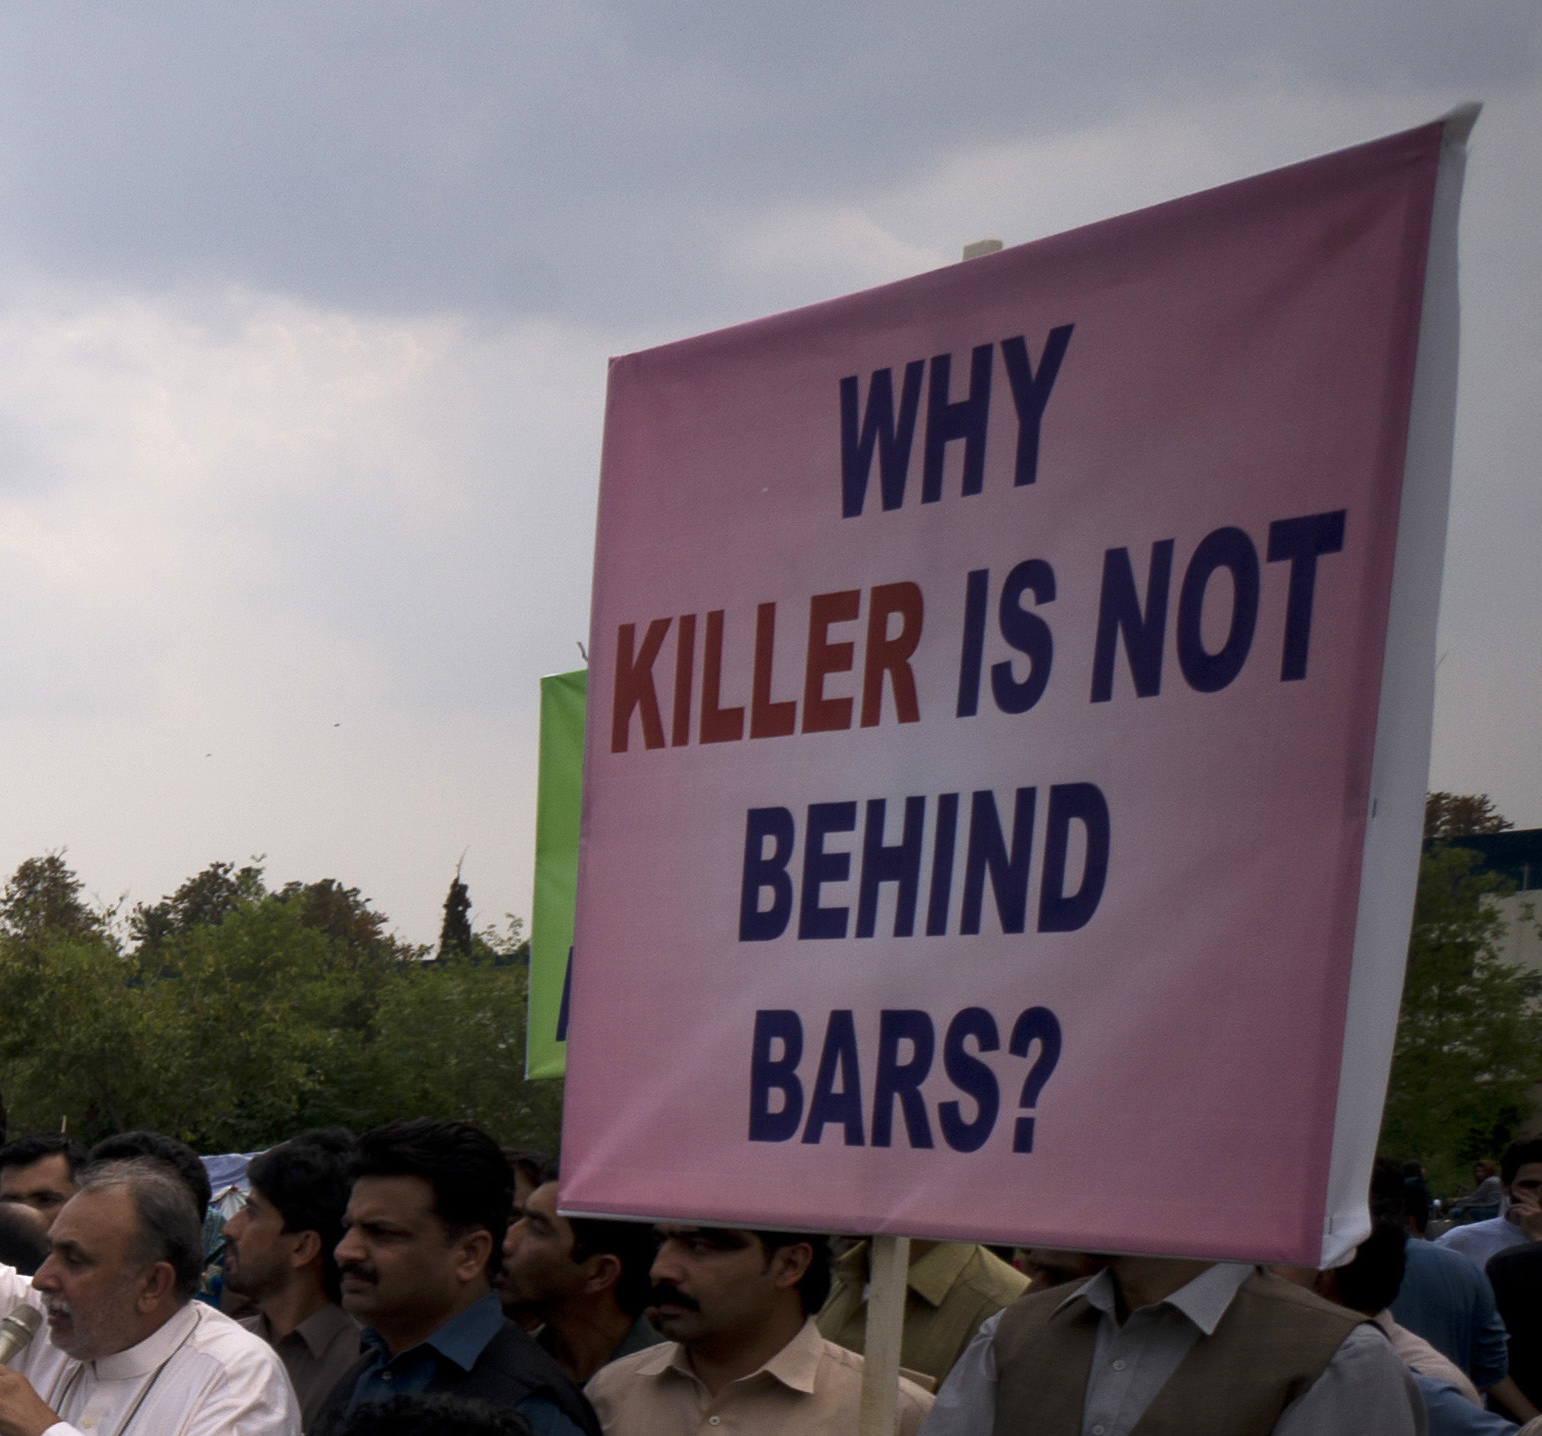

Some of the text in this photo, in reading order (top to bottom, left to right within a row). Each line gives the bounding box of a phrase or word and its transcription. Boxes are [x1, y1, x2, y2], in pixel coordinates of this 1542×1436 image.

[839, 322, 1075, 519] WHY
[609, 508, 1347, 753] KILLER IS NOT
[738, 780, 1112, 942] BEHIND
[748, 1005, 1063, 1154] BARS?
